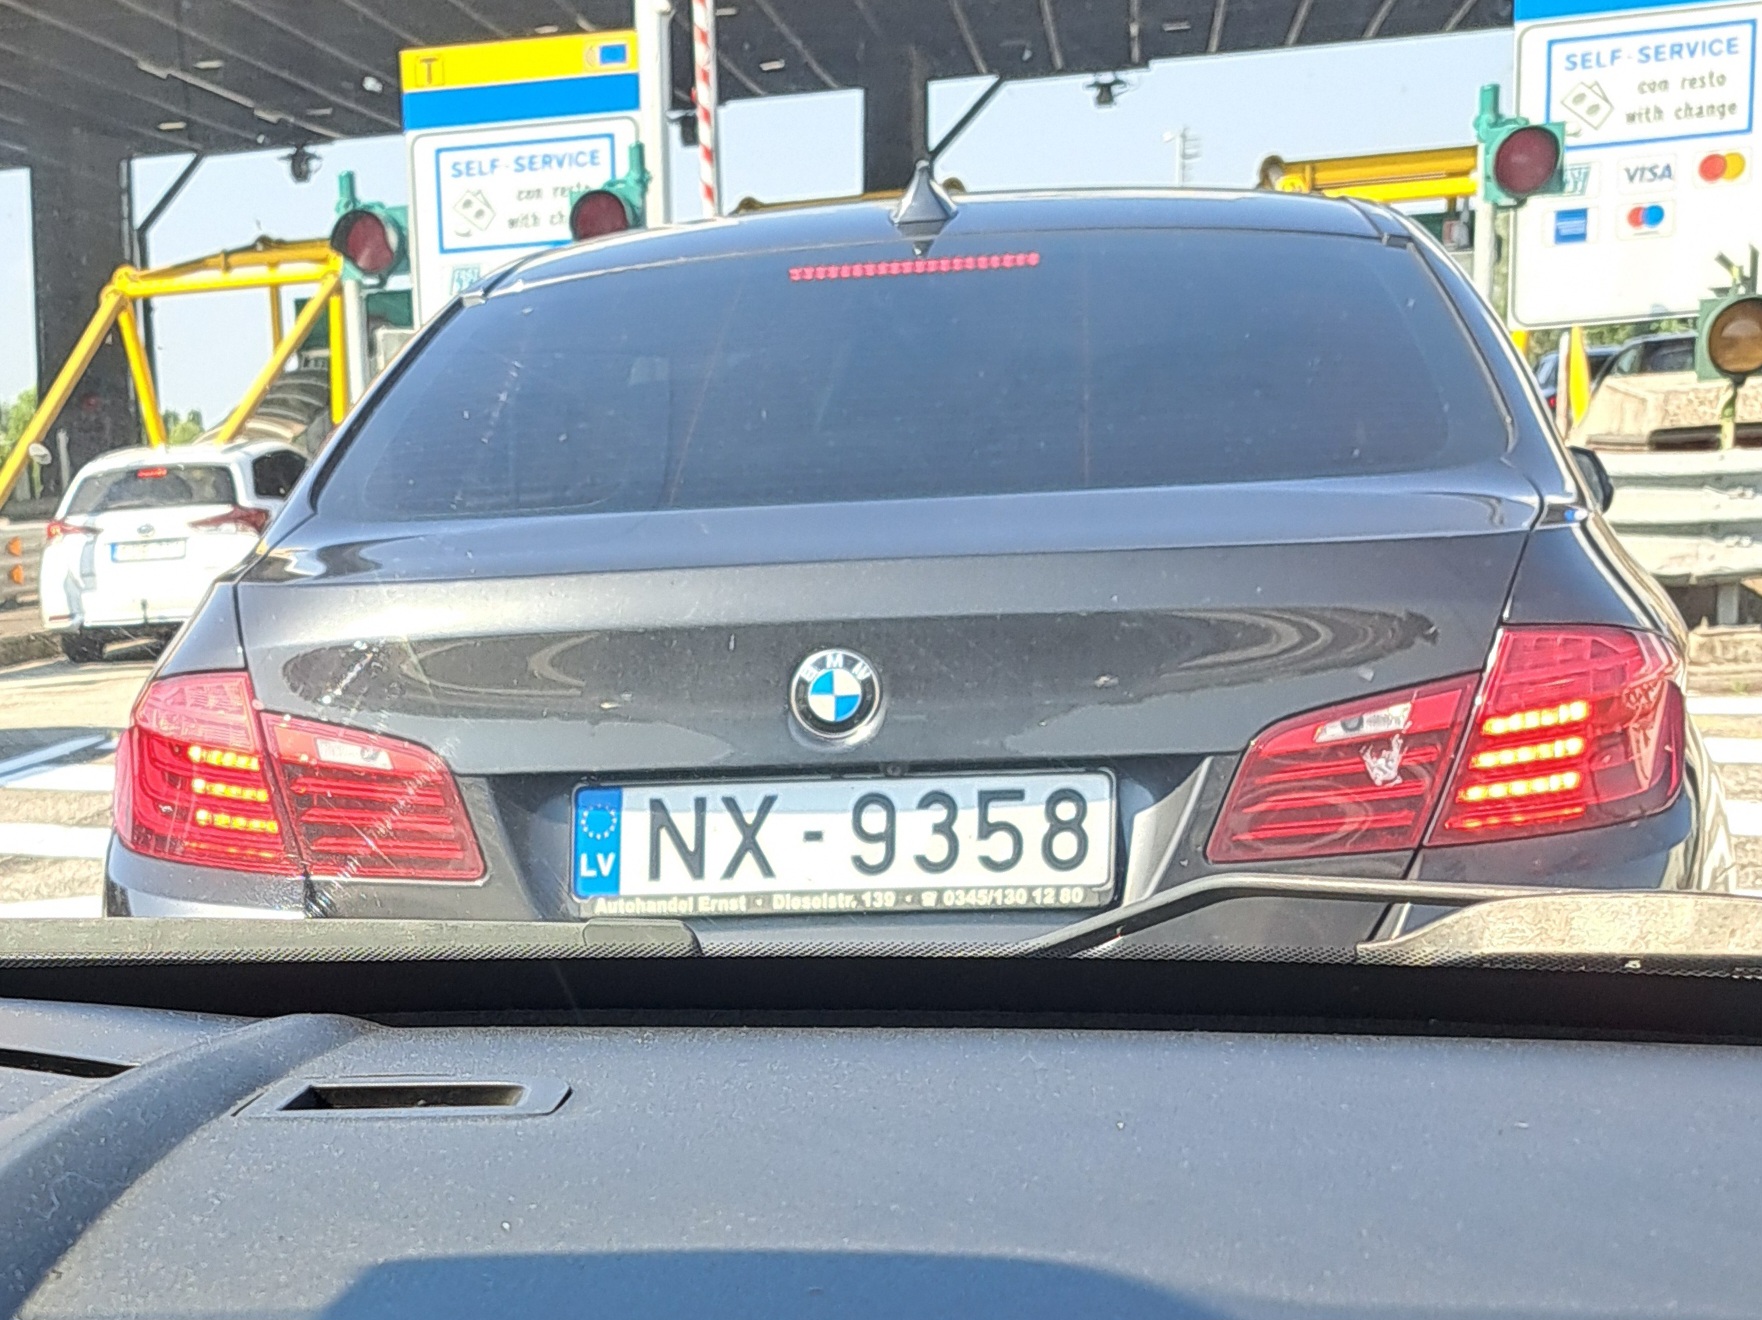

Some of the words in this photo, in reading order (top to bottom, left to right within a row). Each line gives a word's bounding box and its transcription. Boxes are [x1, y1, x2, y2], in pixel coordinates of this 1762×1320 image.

[1637, 78, 1669, 94] con
[1681, 70, 1727, 90] resto
[1626, 105, 1664, 124] with
[1674, 102, 1738, 122] change
[1624, 163, 1673, 183] VISA
[799, 652, 872, 683] BMW
[580, 852, 616, 878] LV
[594, 896, 694, 915] Autohandel
[698, 895, 747, 913] Ernst
